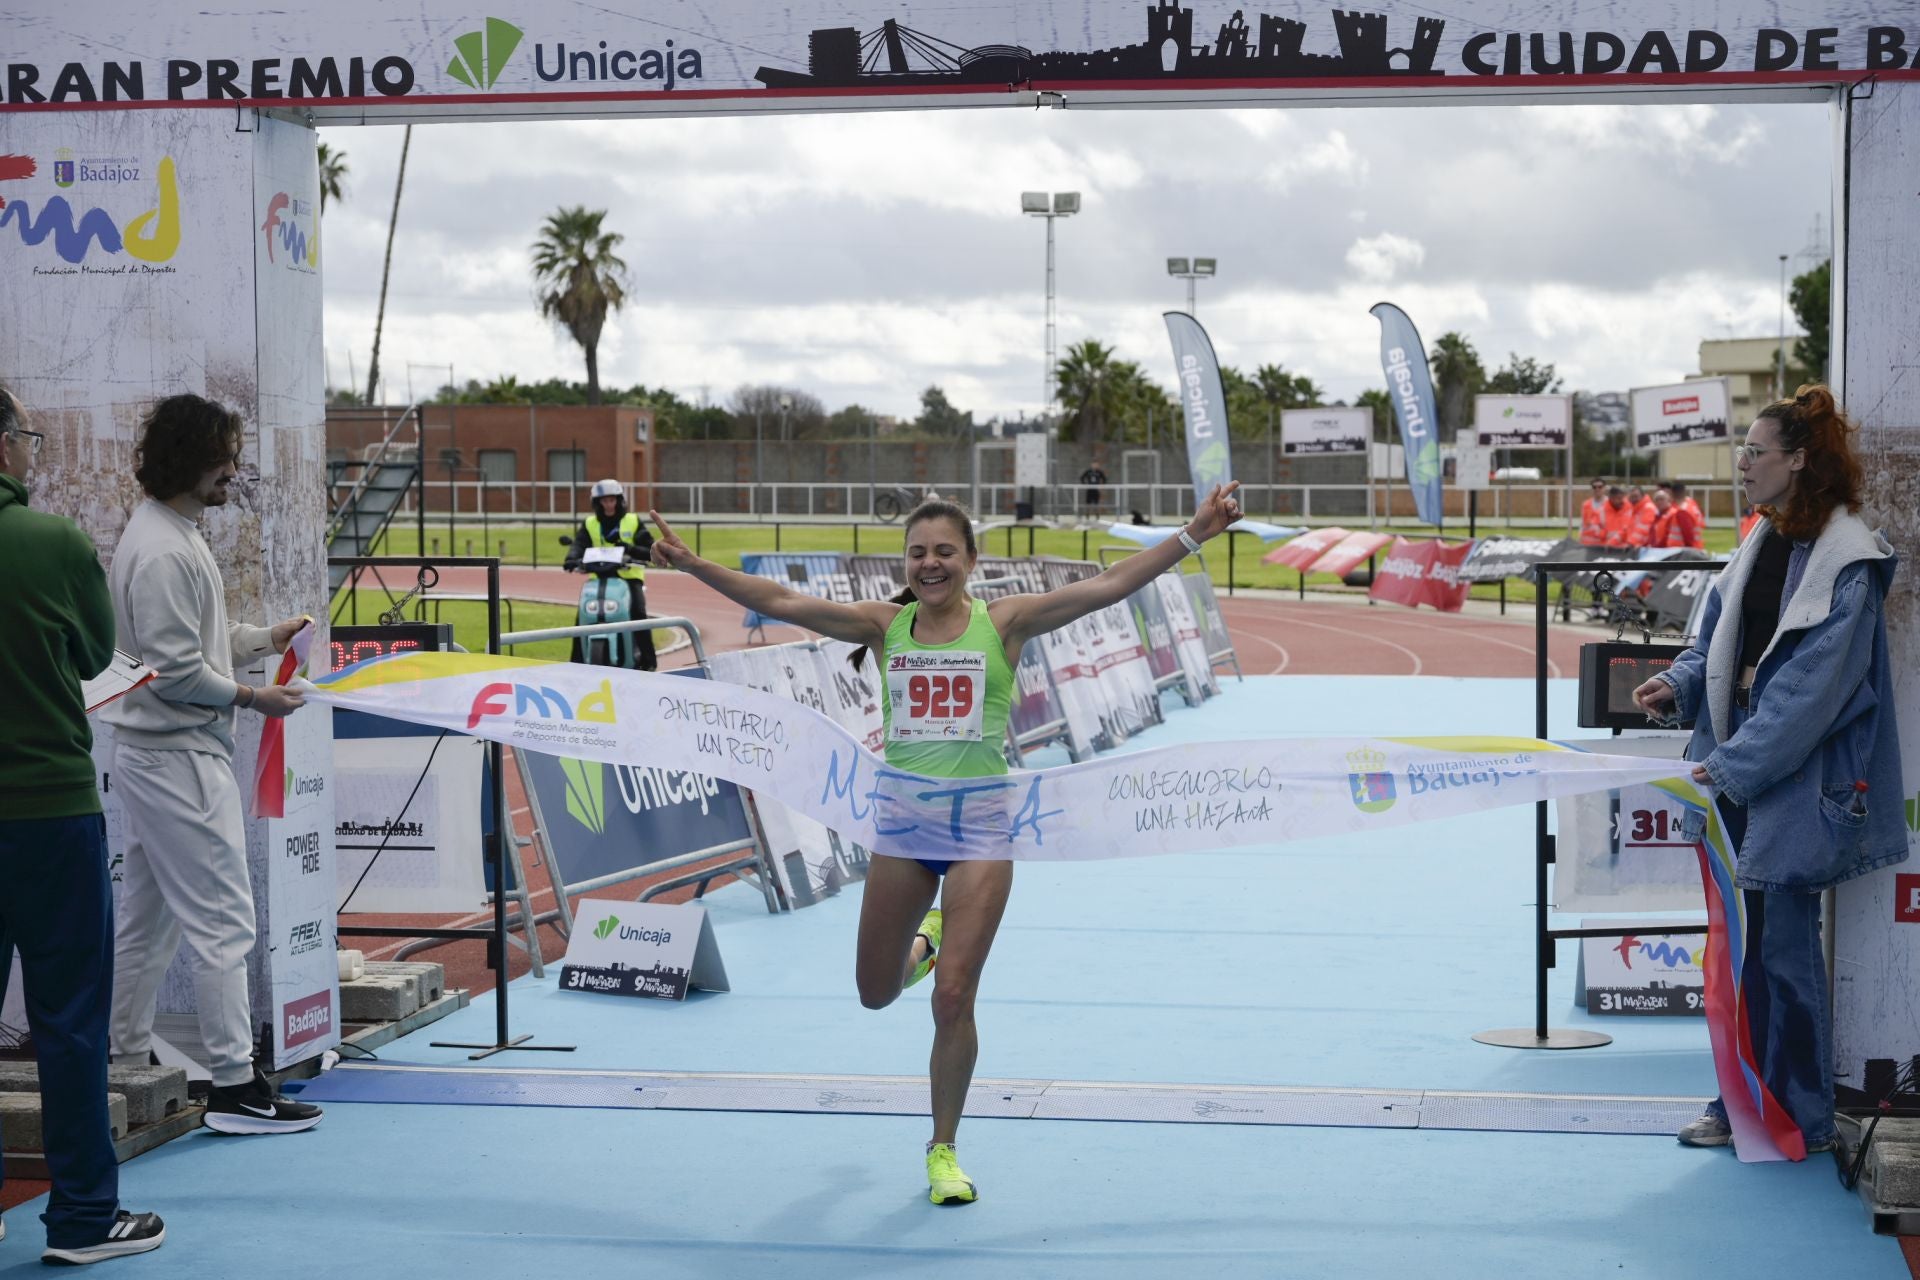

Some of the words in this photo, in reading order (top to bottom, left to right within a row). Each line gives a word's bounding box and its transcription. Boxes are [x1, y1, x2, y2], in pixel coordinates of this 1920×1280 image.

[1461, 29, 1729, 76] CIUDAD
[1754, 27, 1839, 72] DE
[1866, 26, 1920, 71] B
[535, 39, 702, 91] Unicaja
[0, 62, 144, 103] RAN
[167, 55, 415, 101] PREMIO
[80, 157, 129, 165] Ayuntamiento
[80, 164, 140, 184] Badajoz
[81, 264, 126, 276] Municipal
[128, 265, 138, 273] de
[141, 264, 177, 275] Deportes
[891, 655, 907, 669] 31
[467, 678, 617, 729] fmd
[908, 674, 973, 718] 929
[512, 730, 525, 738] de
[526, 730, 566, 743] Deportes
[568, 736, 581, 744] de
[582, 737, 617, 749] Badajoz
[559, 722, 600, 735] Municipal
[696, 732, 723, 756] UN
[726, 737, 774, 772] RETO
[1406, 757, 1510, 776] Ayuntamiento
[1514, 753, 1533, 765] de
[295, 772, 324, 797] Unicaja
[613, 764, 719, 816] Unicaja
[821, 744, 1064, 846] META
[1135, 803, 1179, 833] UNA
[1631, 809, 1669, 841] 31
[286, 831, 320, 858] POWER
[302, 851, 320, 876] ADE
[289, 918, 322, 945] FAEX
[619, 925, 672, 947] Unicaja
[568, 970, 588, 988] 31
[634, 975, 646, 992] 9
[1599, 992, 1623, 1010] 31
[1685, 992, 1699, 1009] 9
[288, 1005, 329, 1035] Badajoz
